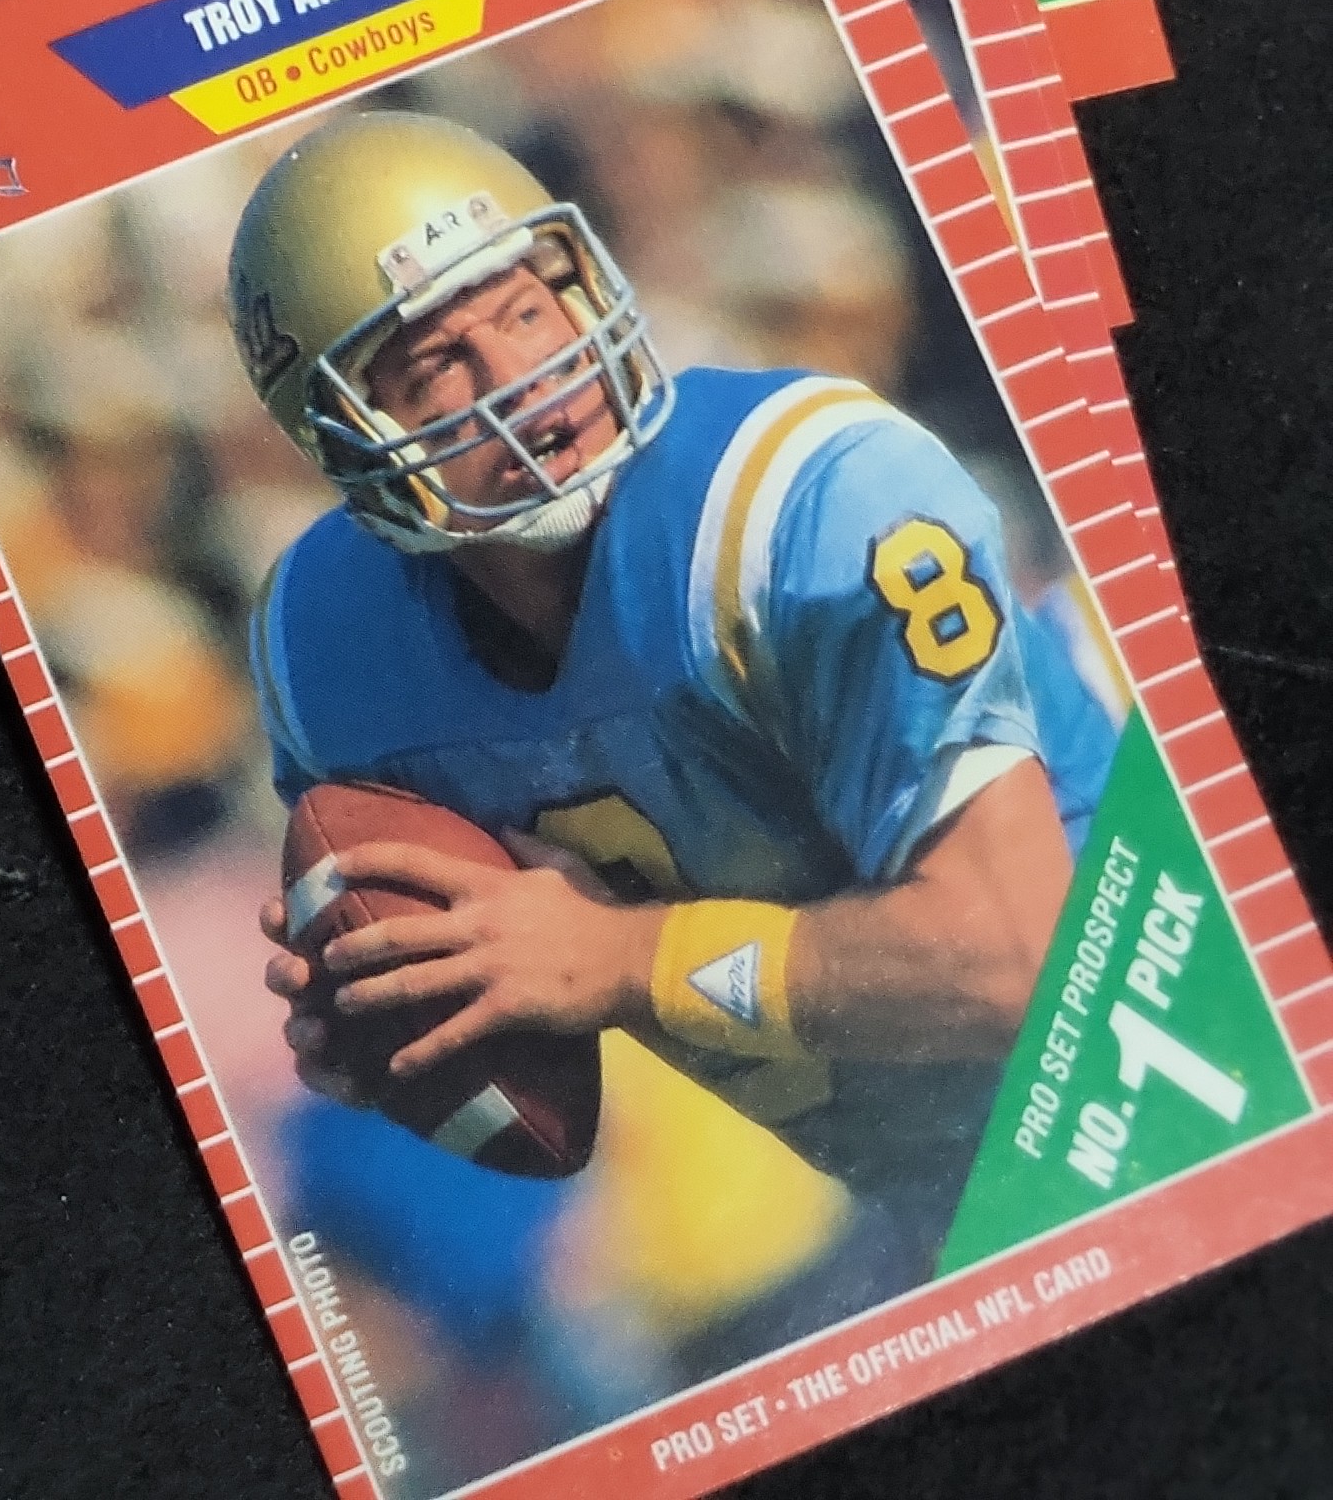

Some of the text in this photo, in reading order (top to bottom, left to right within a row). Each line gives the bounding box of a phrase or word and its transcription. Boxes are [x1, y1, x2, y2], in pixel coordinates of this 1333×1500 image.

[236, 11, 435, 103] QB Cowboys
[863, 510, 1005, 686] 8
[1014, 835, 1139, 1160] PRO SET PROSPECT
[1066, 871, 1248, 1190] NO. 1 PICK
[289, 1231, 406, 1477] SCOUTING PHOTO
[650, 1247, 1113, 1472] PRO SET THE OFFICIAL NFL CARD
